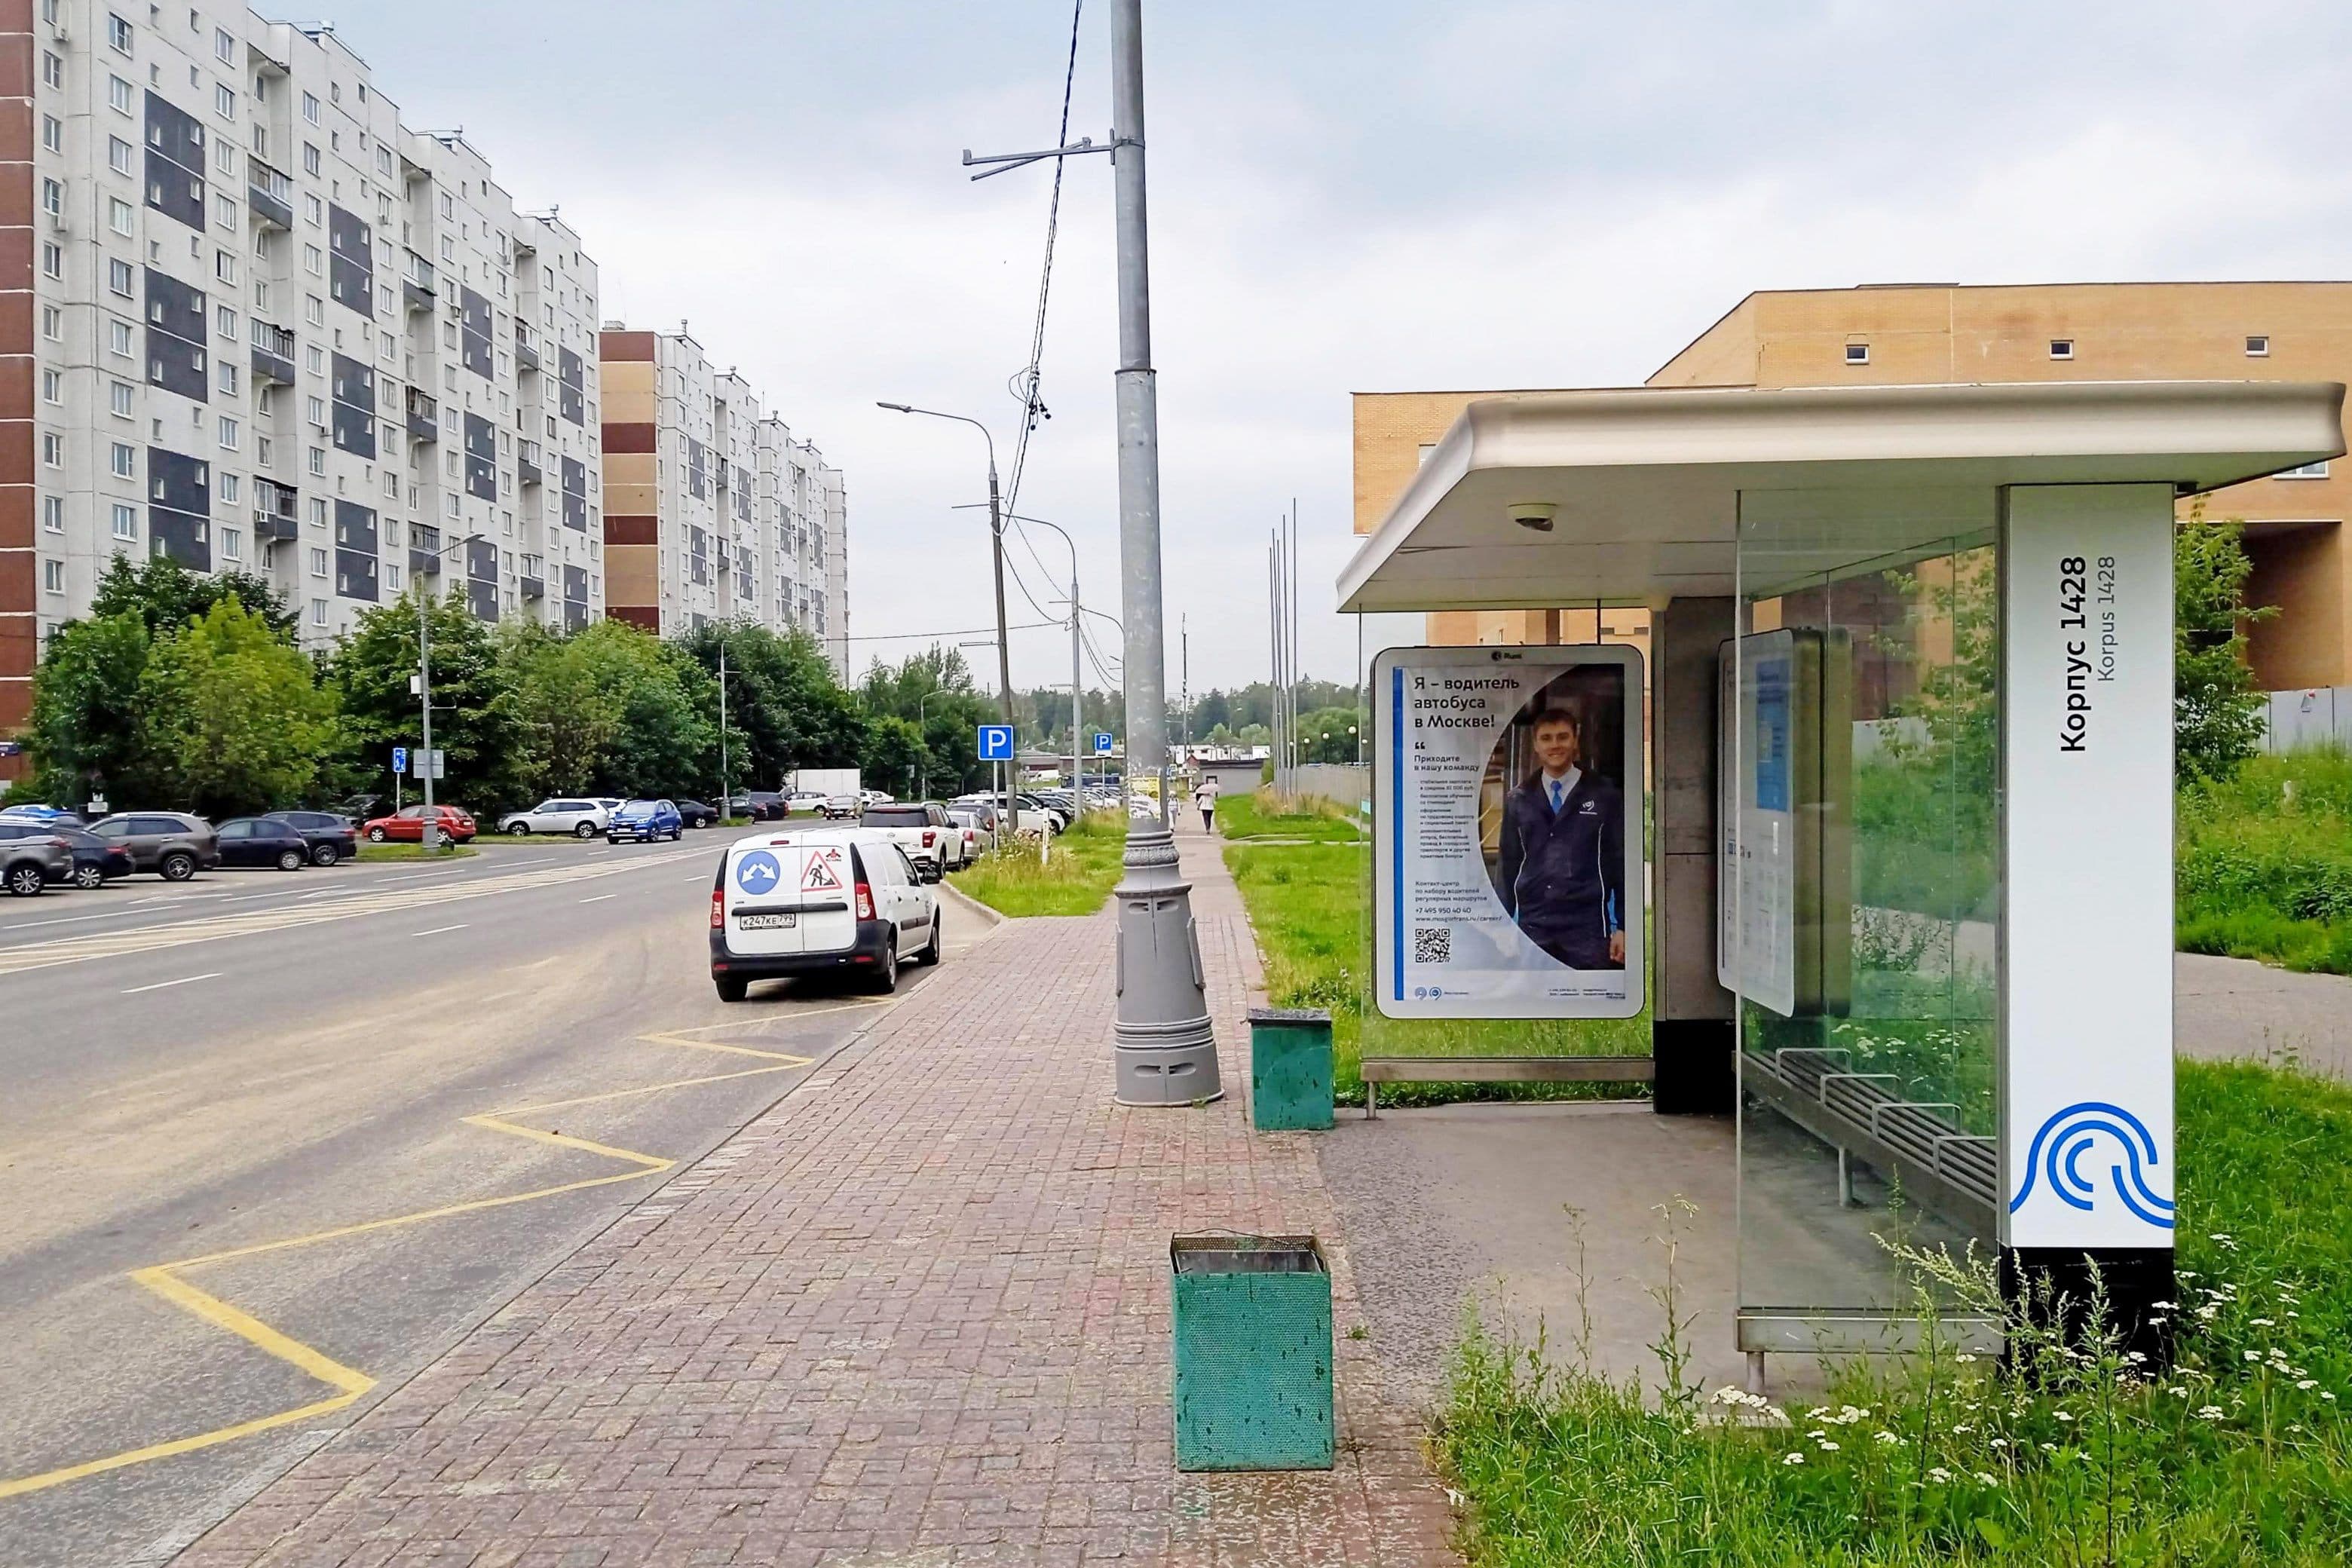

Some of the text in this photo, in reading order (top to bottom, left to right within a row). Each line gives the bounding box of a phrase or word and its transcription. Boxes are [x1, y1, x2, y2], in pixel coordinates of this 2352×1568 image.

[2097, 556, 2119, 681] Korpus 1428
[2060, 556, 2092, 752] Корпус 1428
[1414, 676, 1425, 690] Я
[1444, 678, 1521, 691] водитель
[1414, 695, 1486, 712] автобуса
[1414, 714, 1495, 728] в Москве!
[1414, 755, 1460, 764] Приходите
